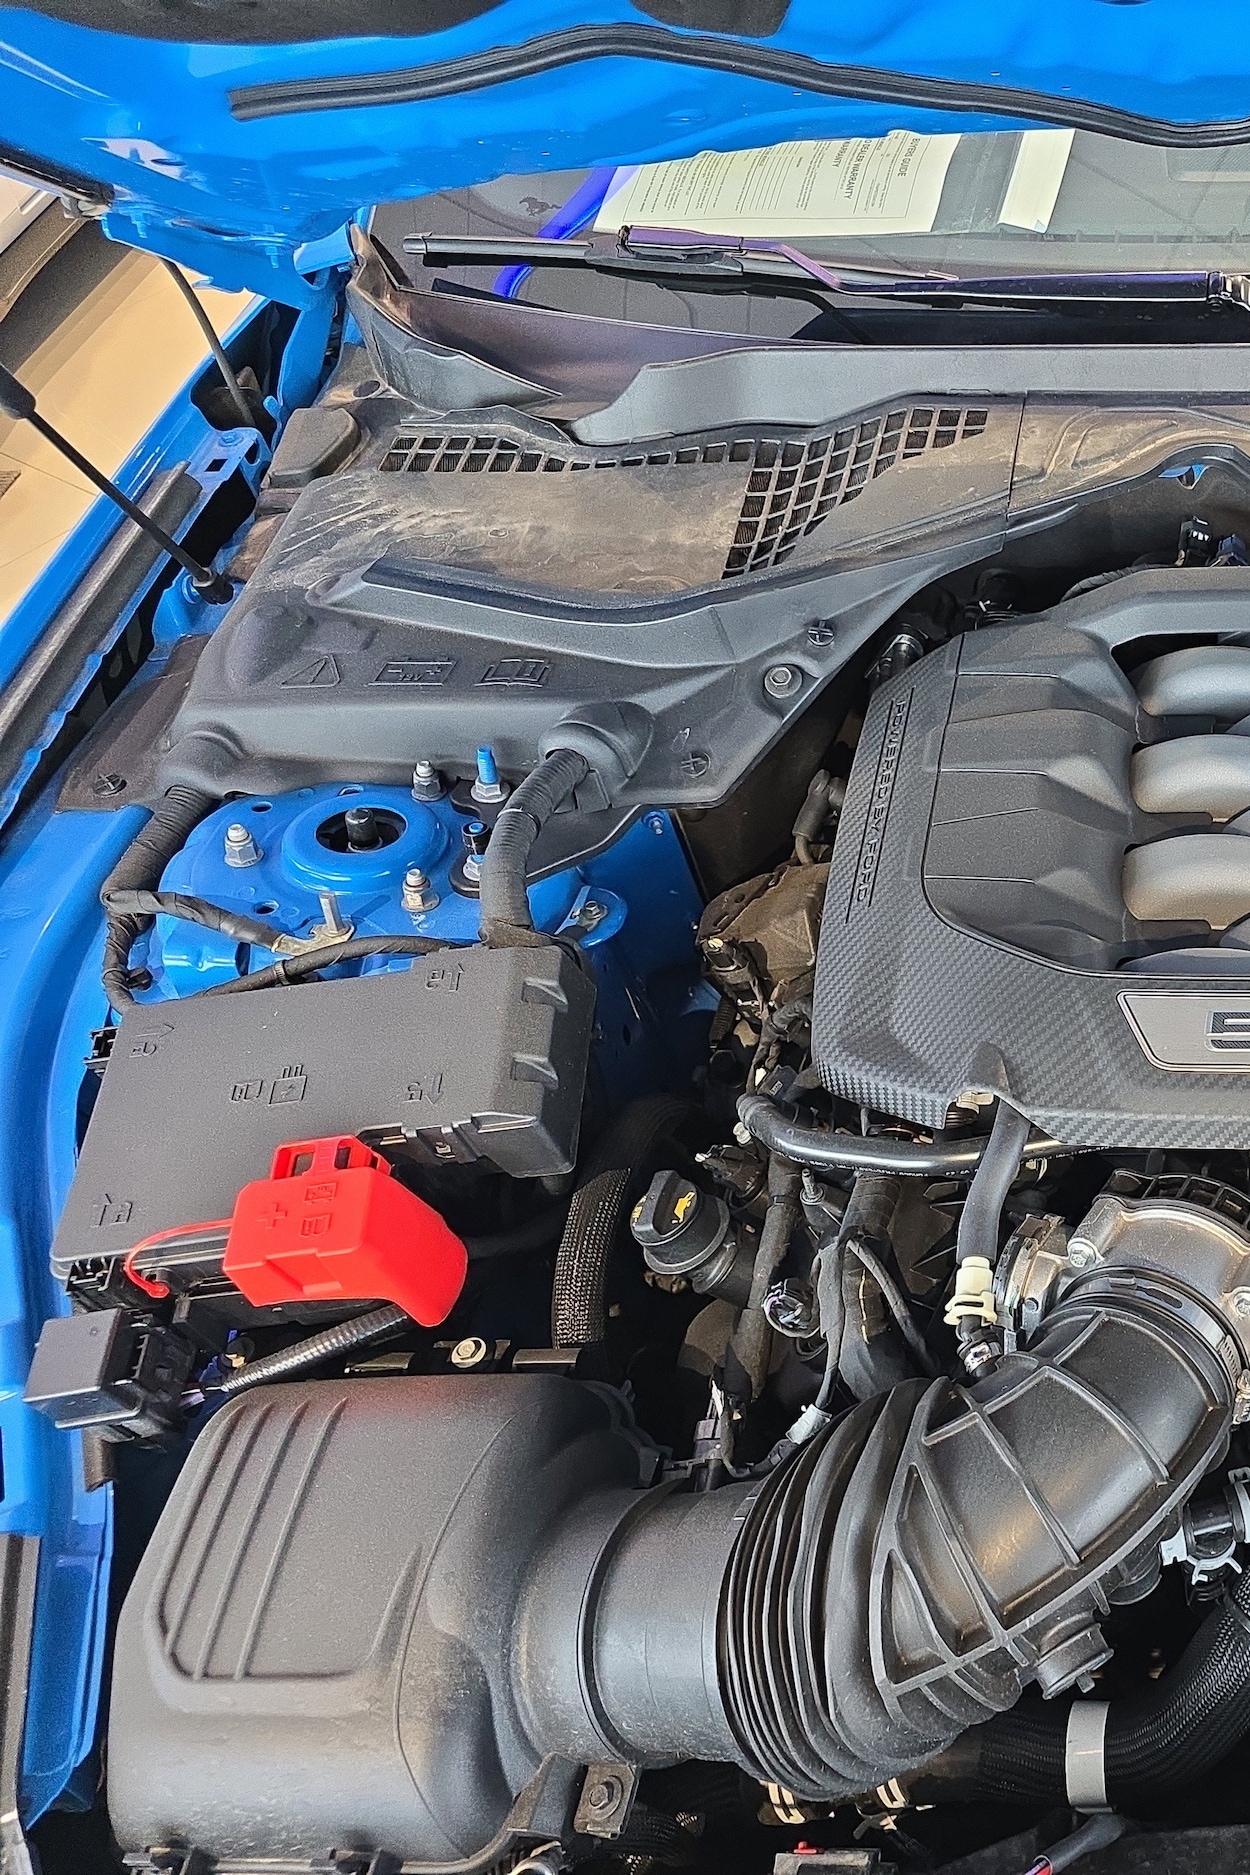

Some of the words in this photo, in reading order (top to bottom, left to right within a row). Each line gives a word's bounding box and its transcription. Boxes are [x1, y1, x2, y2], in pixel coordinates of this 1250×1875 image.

[855, 143, 871, 163] DEALER
[905, 138, 921, 158] BUYERS
[844, 161, 862, 200] WARRANTY
[897, 158, 912, 177] GUIDE
[876, 697, 908, 799] POWERED
[869, 806, 886, 833] BY
[856, 840, 879, 902] FORD
